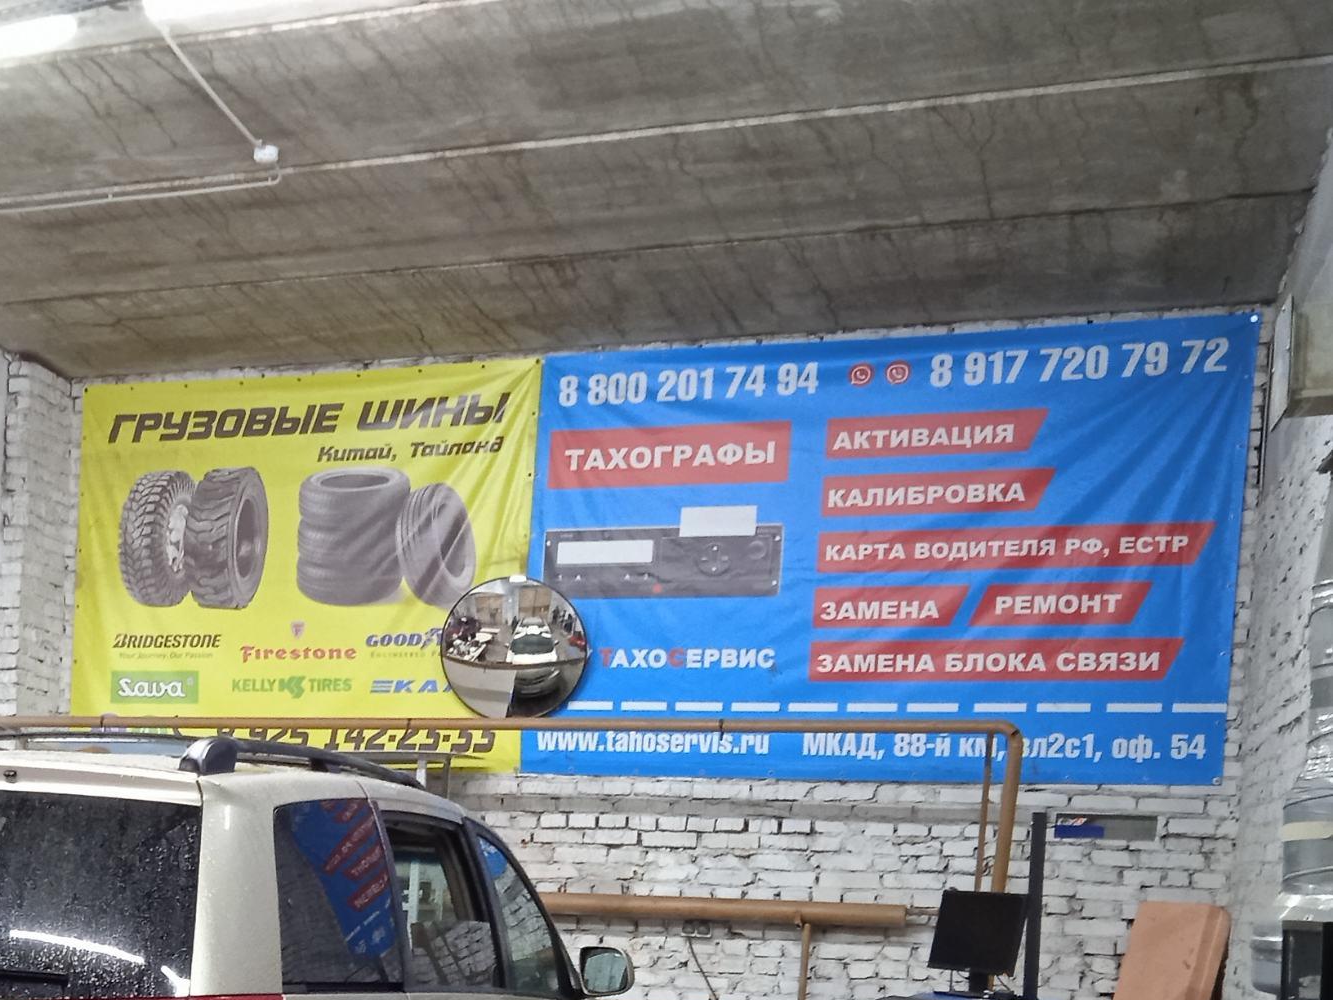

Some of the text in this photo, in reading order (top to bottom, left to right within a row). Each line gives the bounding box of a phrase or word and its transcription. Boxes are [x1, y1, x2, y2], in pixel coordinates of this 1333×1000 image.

[930, 337, 1229, 387] 8 917 720 79 72
[559, 362, 818, 407] 8 800 201 74 94
[108, 392, 511, 444] ГРУЗОВЫЕ ШИНЫ
[317, 436, 505, 462] Китай, Тайланд
[833, 424, 1014, 451] АКТИВАЦИЯ
[564, 441, 777, 472] ТАХОГРАФЫ
[827, 483, 1025, 508] КАЛИБРОВКА
[825, 535, 1190, 561] КАРТА ВОДИТЕЛЯ РФ, ЕСТР
[820, 599, 940, 620] ЗАМЕНА
[995, 594, 1123, 615] РЕМОНТ
[113, 633, 222, 649] BRIDGESTONE
[365, 627, 442, 649] GOOD
[240, 646, 357, 663] Firestone
[601, 648, 775, 669] ТАХОСЕРВИС
[816, 651, 1160, 673] ЗАМЕНА БЛОКА СВЯЗИ
[117, 677, 186, 697] Sava
[232, 678, 276, 692] KELLY
[308, 677, 353, 692] TIRES
[393, 679, 452, 693] KA
[537, 730, 770, 755] www.tahoservis.ru
[803, 732, 885, 760] МКАД,
[893, 732, 952, 757] 88-й
[1111, 734, 1161, 763] оф.
[1170, 733, 1207, 760] 54
